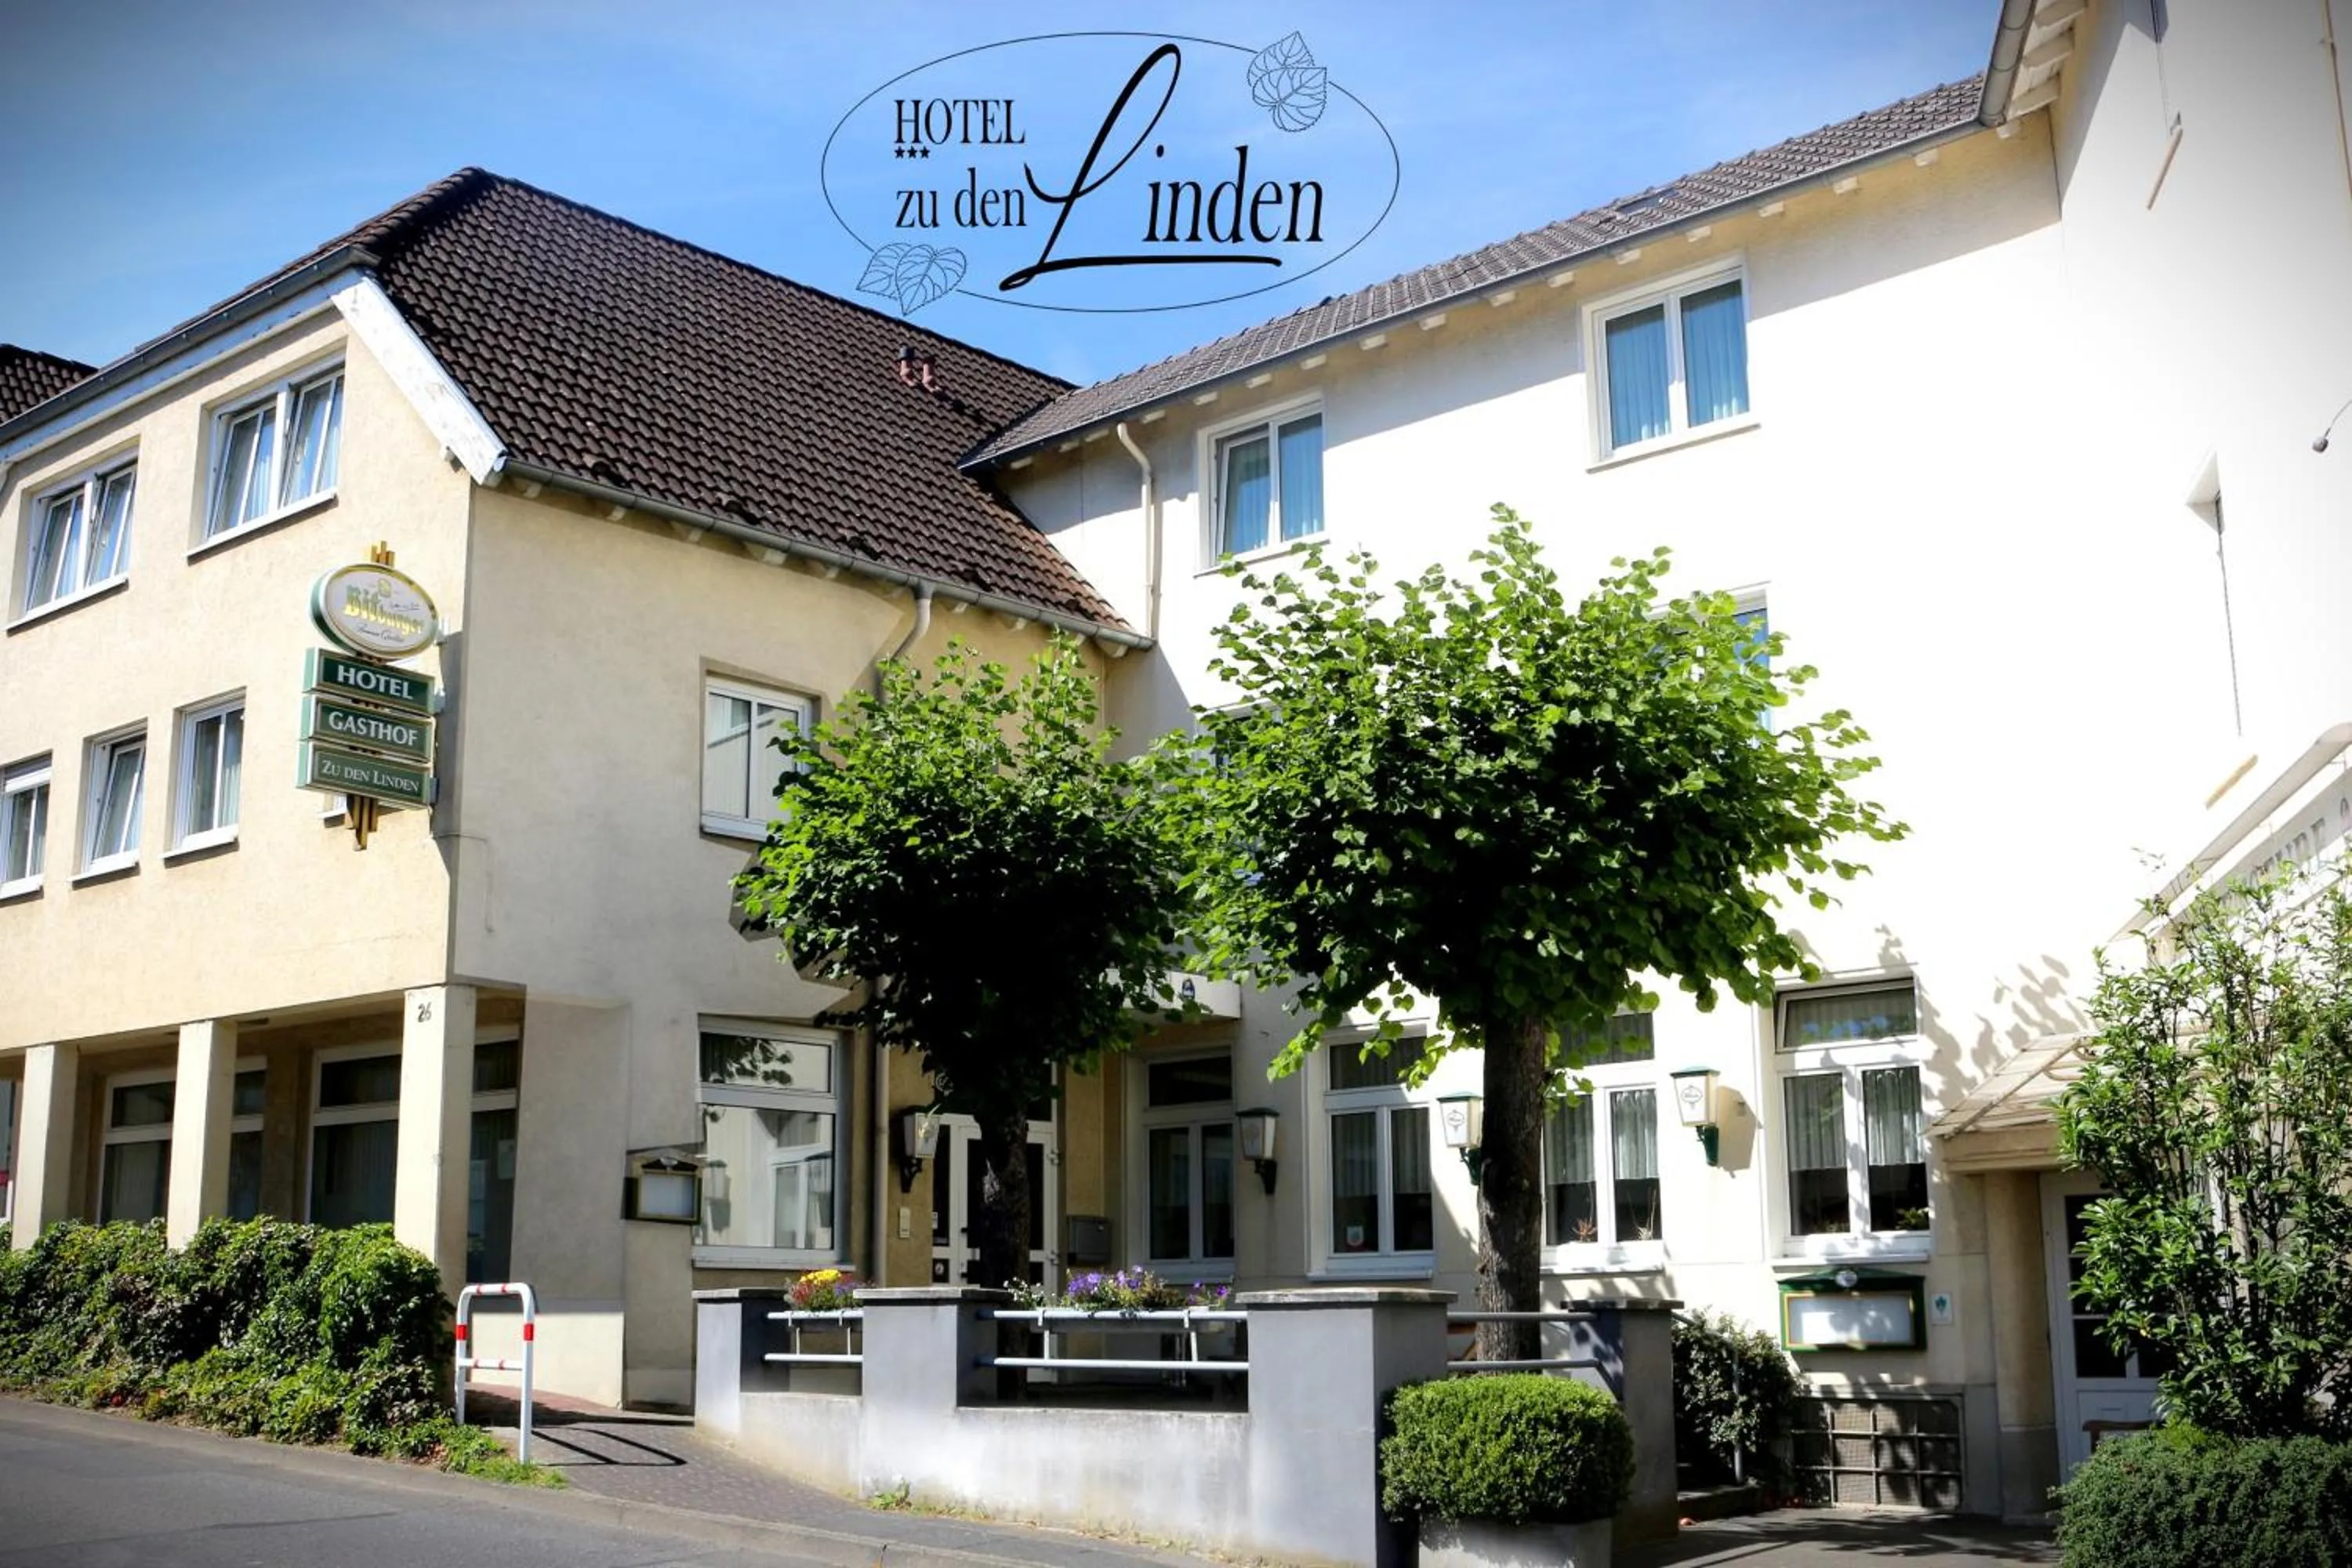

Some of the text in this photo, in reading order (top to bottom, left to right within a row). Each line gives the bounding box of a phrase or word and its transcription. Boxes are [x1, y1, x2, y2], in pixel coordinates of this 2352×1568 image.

[337, 664, 414, 700] HOTEL
[328, 710, 418, 746] GASTHOF
[345, 767, 371, 782] DEN
[373, 770, 420, 792] LINDEN
[417, 1002, 432, 1023] 26
